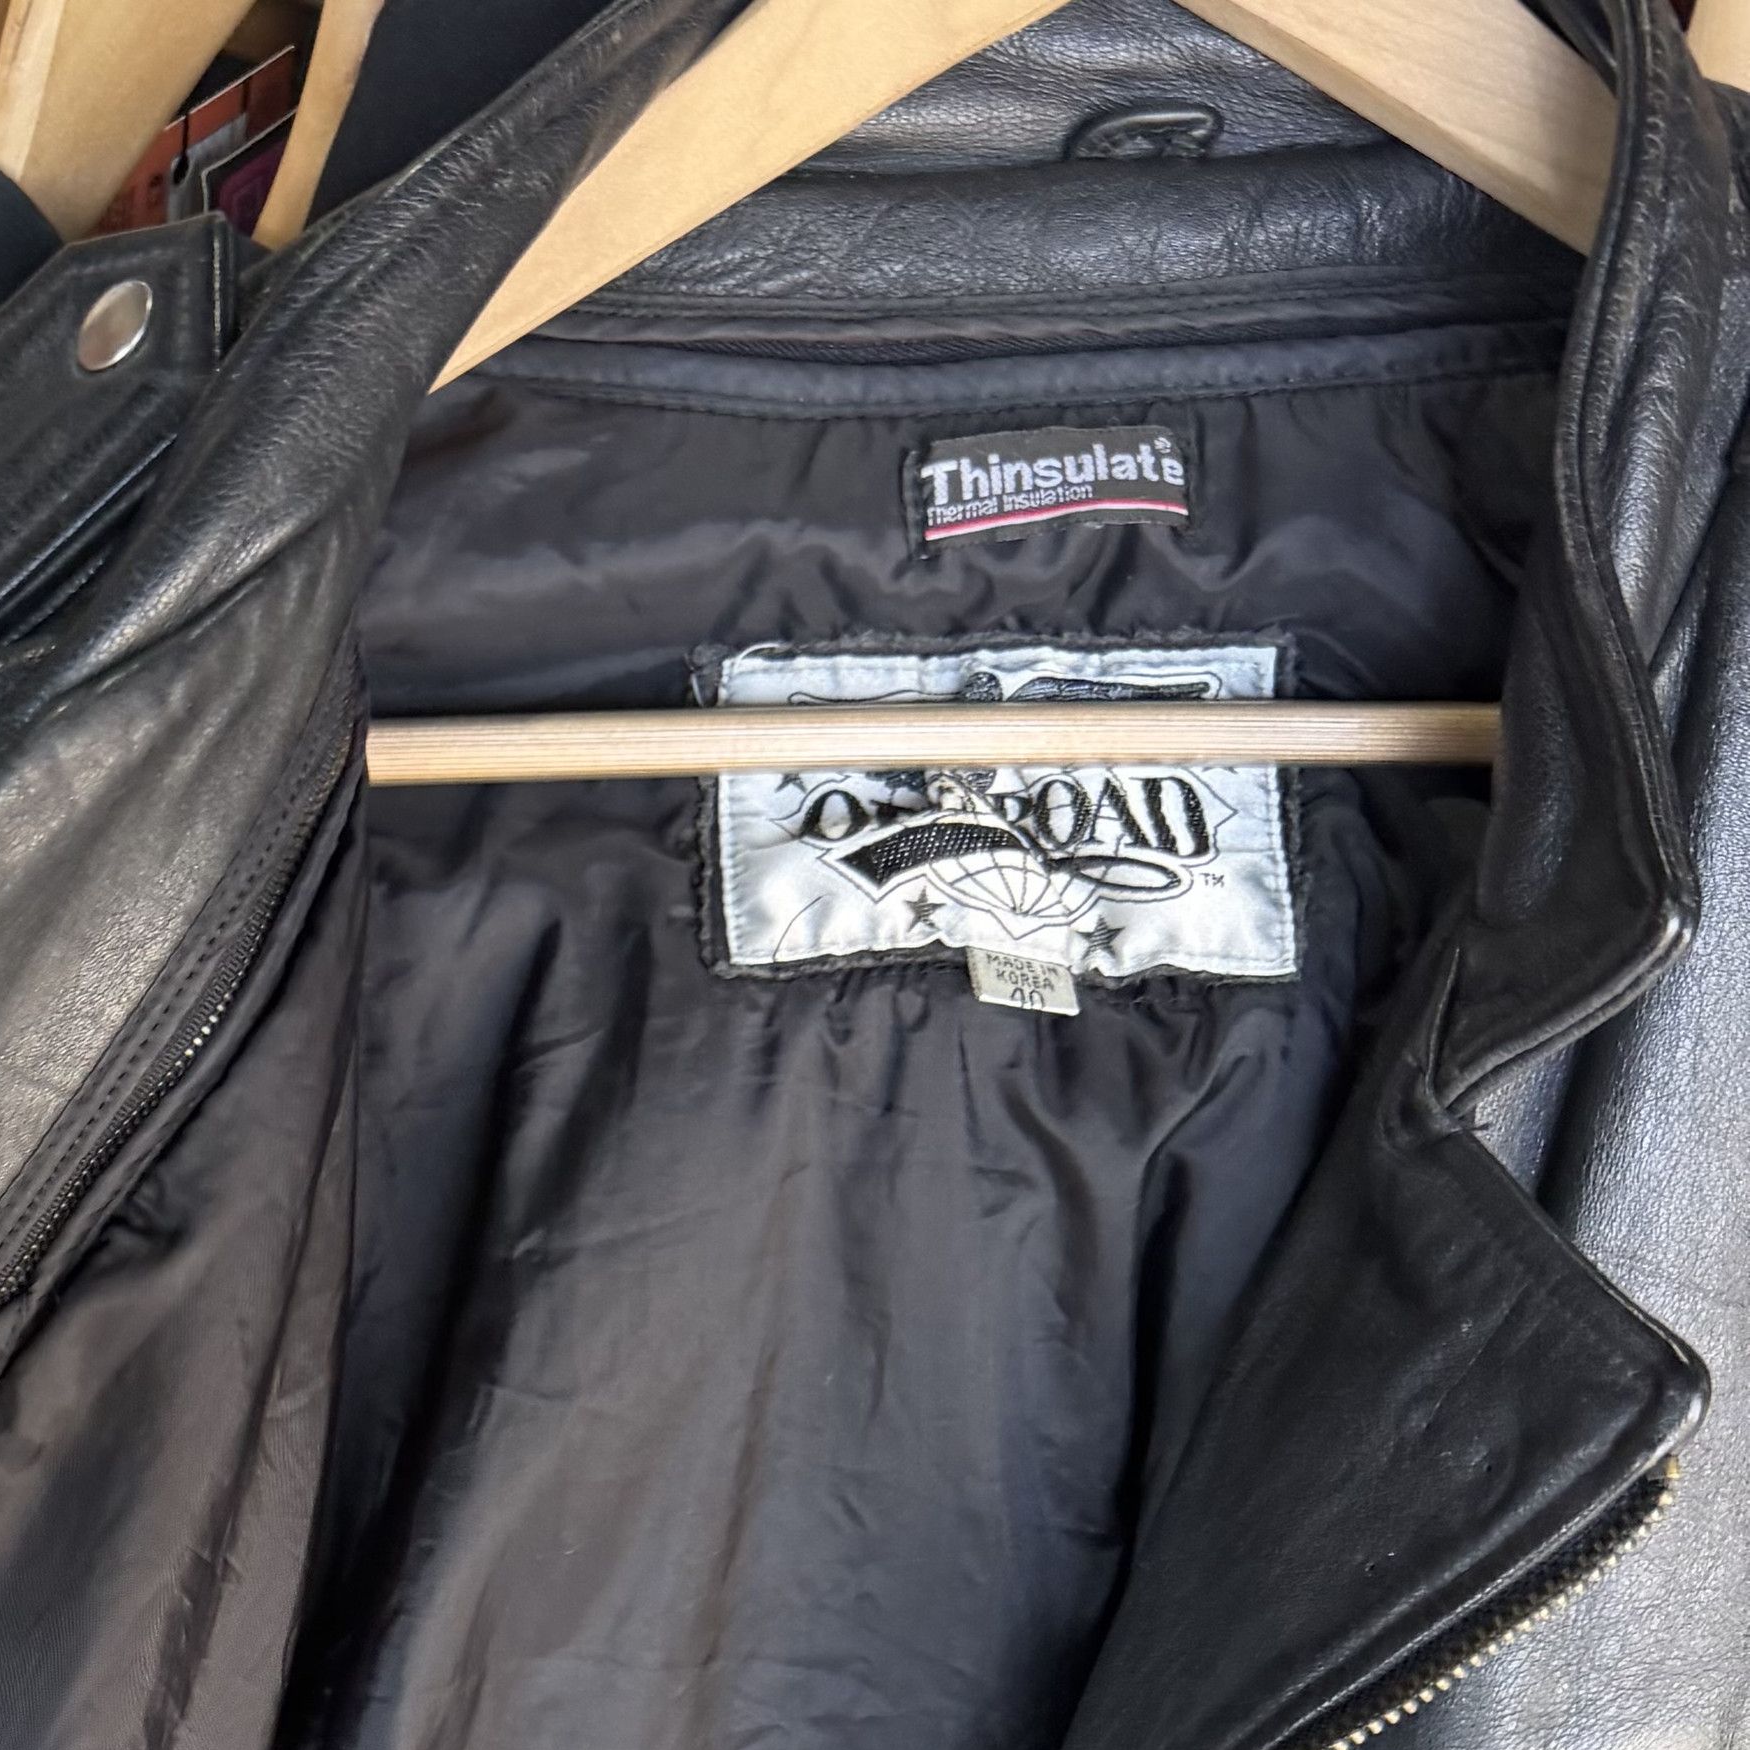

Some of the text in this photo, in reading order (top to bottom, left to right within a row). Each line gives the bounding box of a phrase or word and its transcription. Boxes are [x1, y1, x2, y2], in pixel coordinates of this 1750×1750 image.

[920, 443, 1186, 506] Thinsulate
[985, 953, 1059, 976] MADE IN
[994, 968, 1056, 992] KOREA
